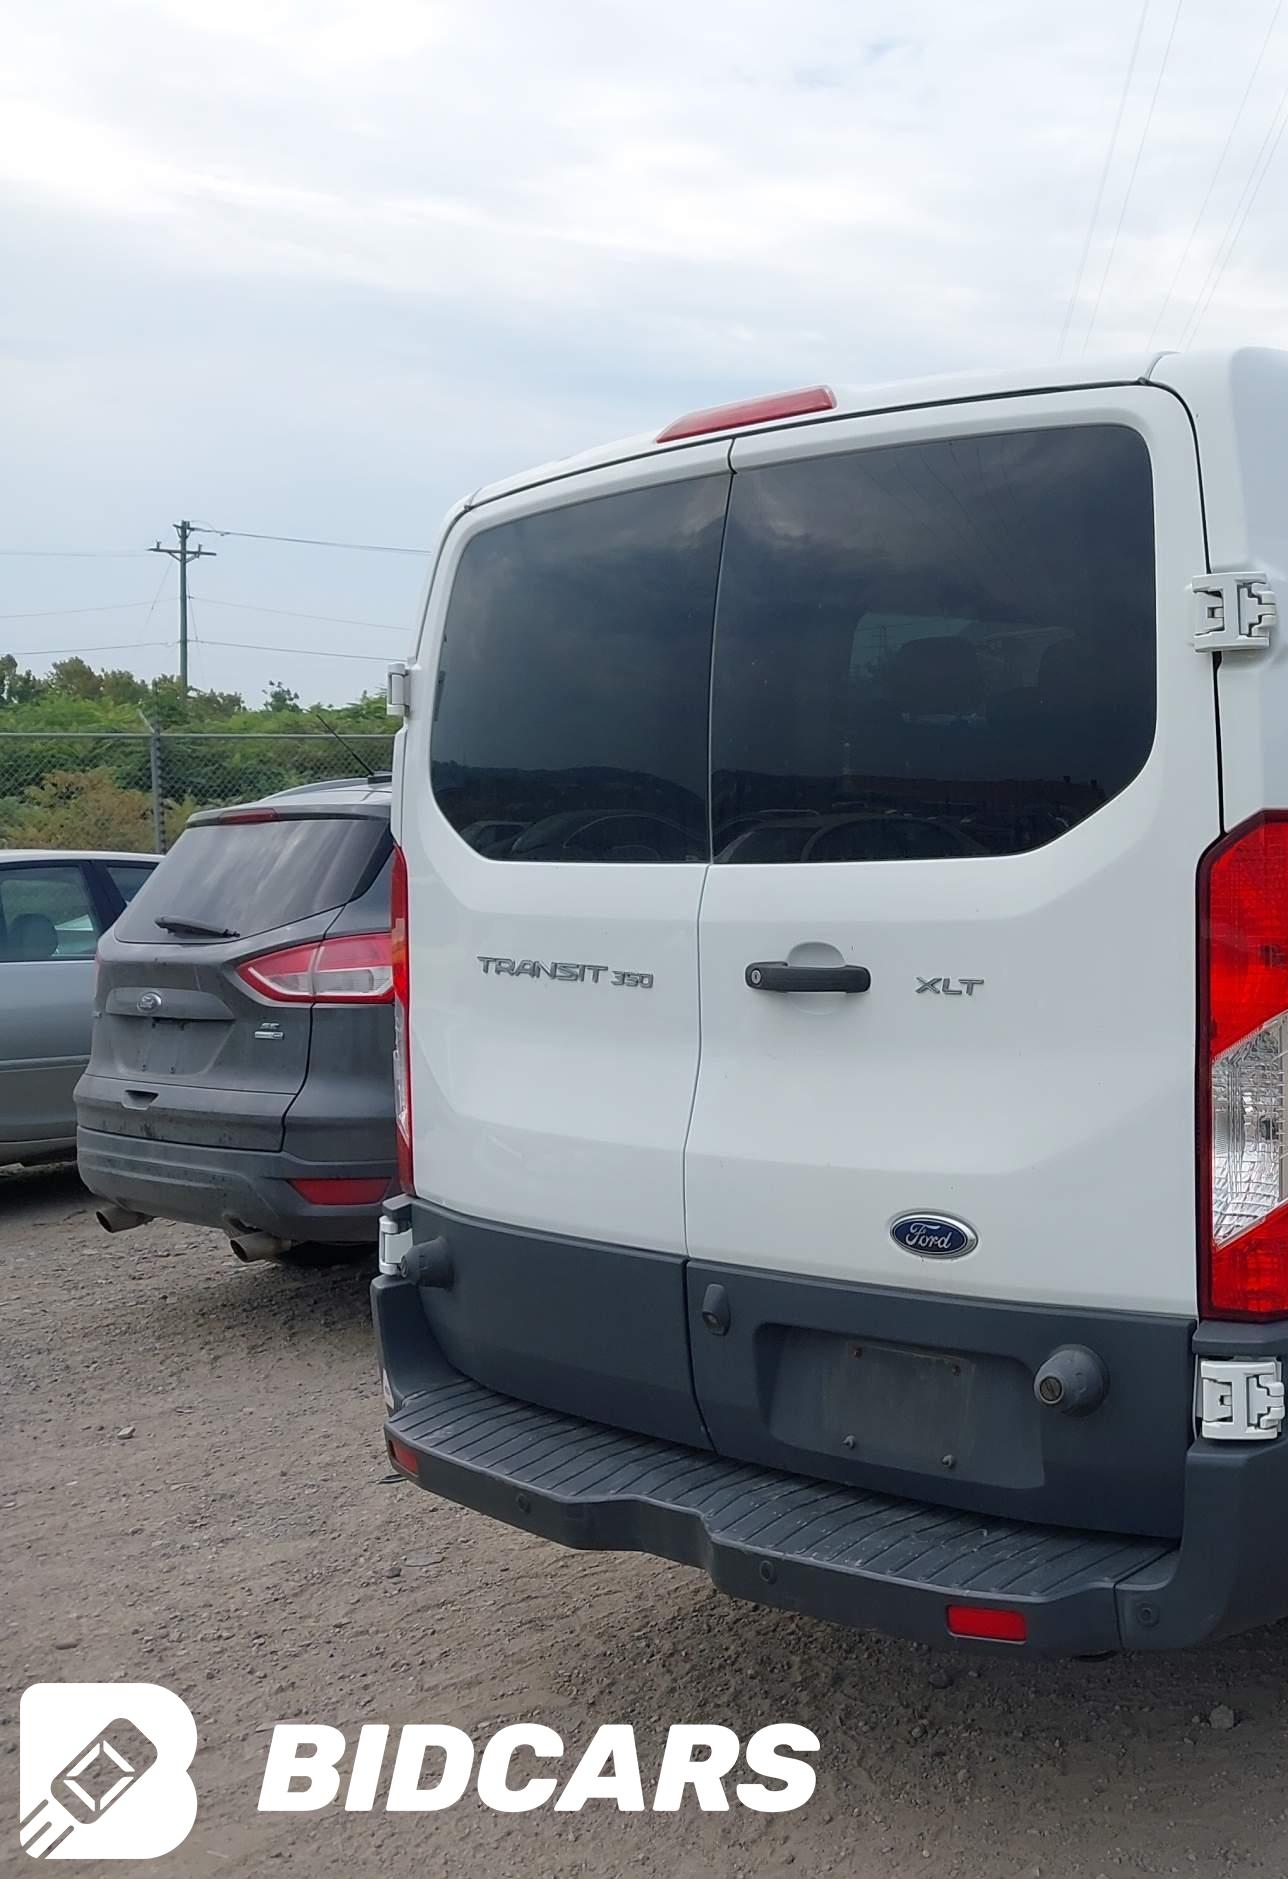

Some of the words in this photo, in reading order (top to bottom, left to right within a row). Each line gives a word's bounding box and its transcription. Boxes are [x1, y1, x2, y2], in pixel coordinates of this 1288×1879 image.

[477, 956, 609, 984] TRANSIT
[610, 970, 655, 989] 350
[915, 976, 985, 996] XLT
[905, 1222, 953, 1249] Ford
